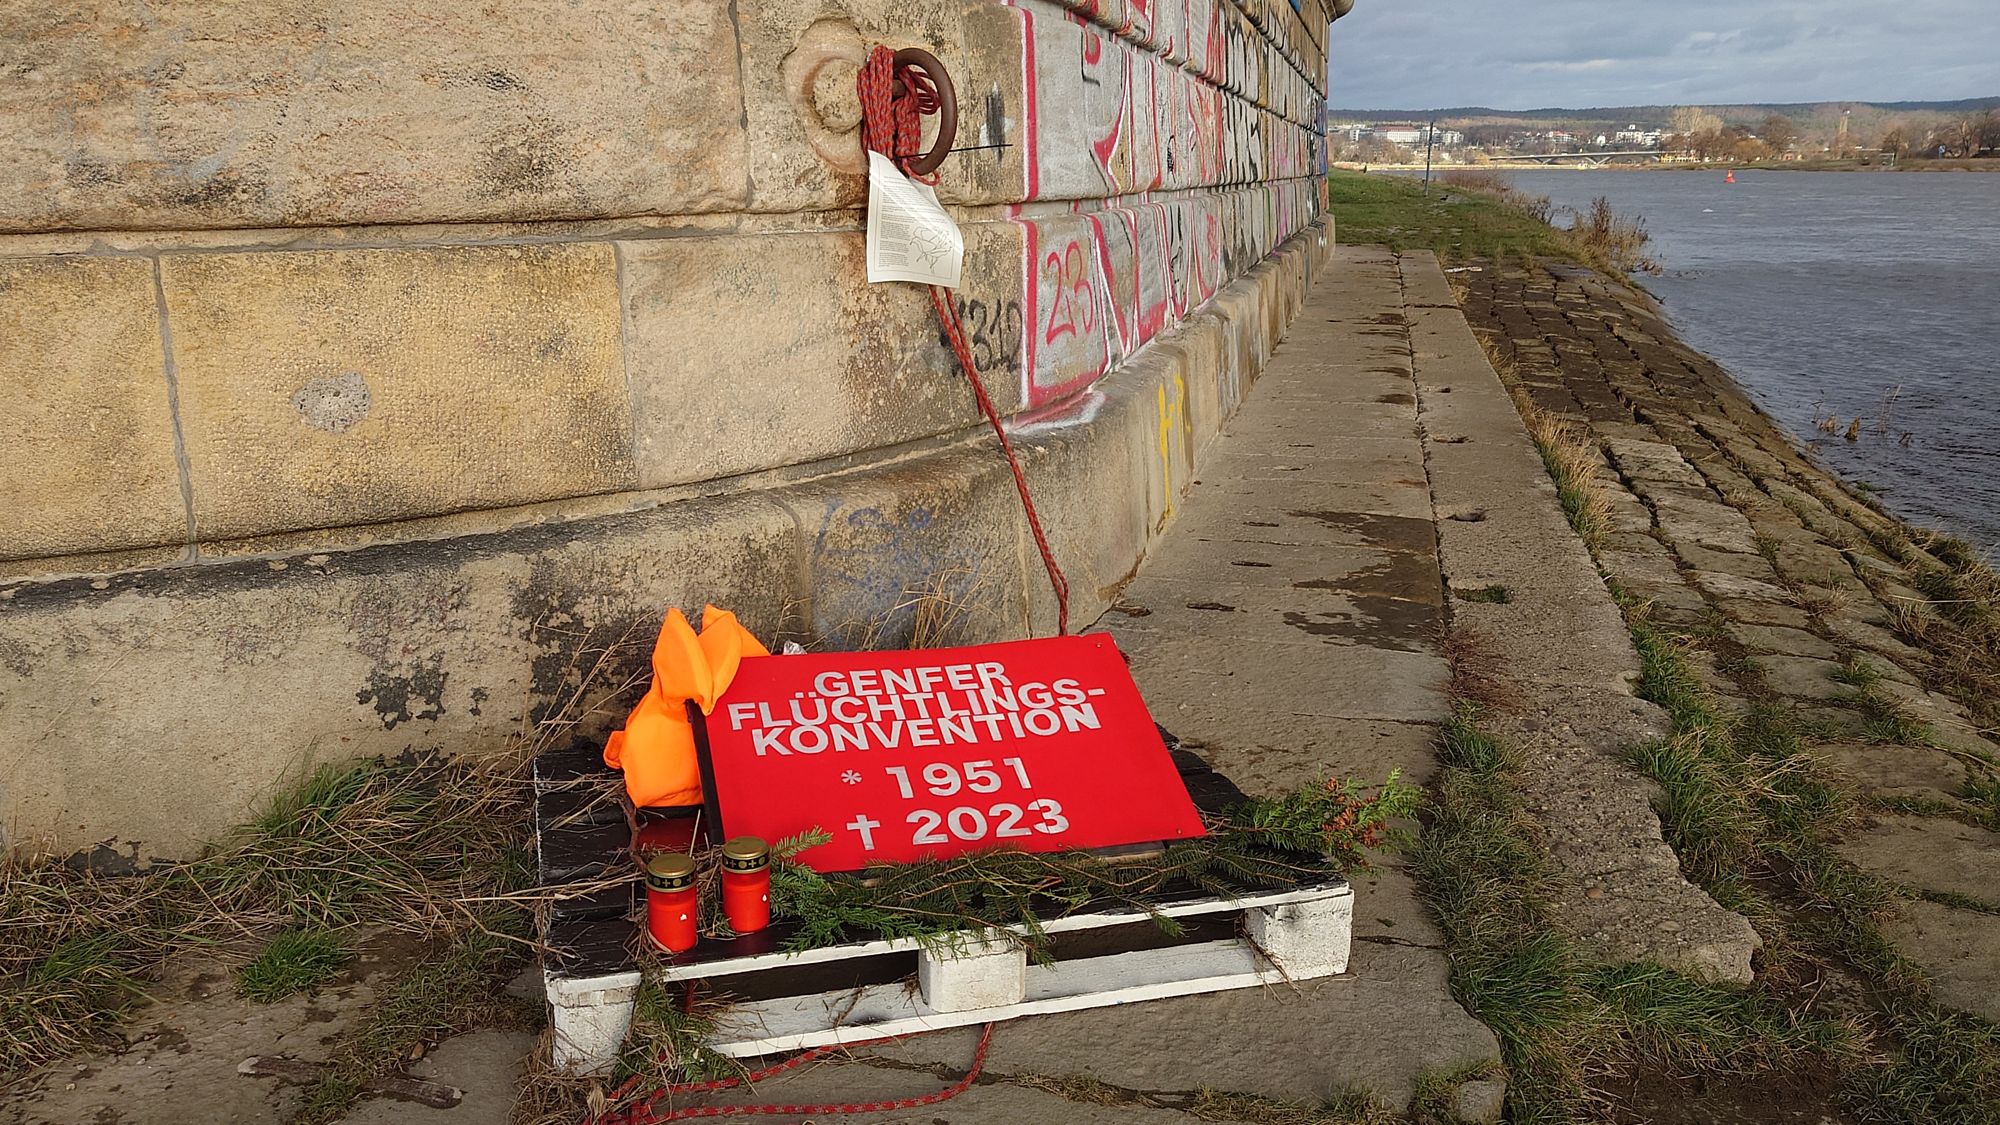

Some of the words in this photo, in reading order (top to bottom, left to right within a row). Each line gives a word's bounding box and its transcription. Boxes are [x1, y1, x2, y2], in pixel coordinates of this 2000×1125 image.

[814, 661, 1007, 698] GENFER
[727, 678, 1106, 731] FLÜCHTLINGS-
[751, 703, 1102, 756] KONVENTION
[885, 756, 1033, 799] 1951
[905, 798, 1070, 846] 2023
